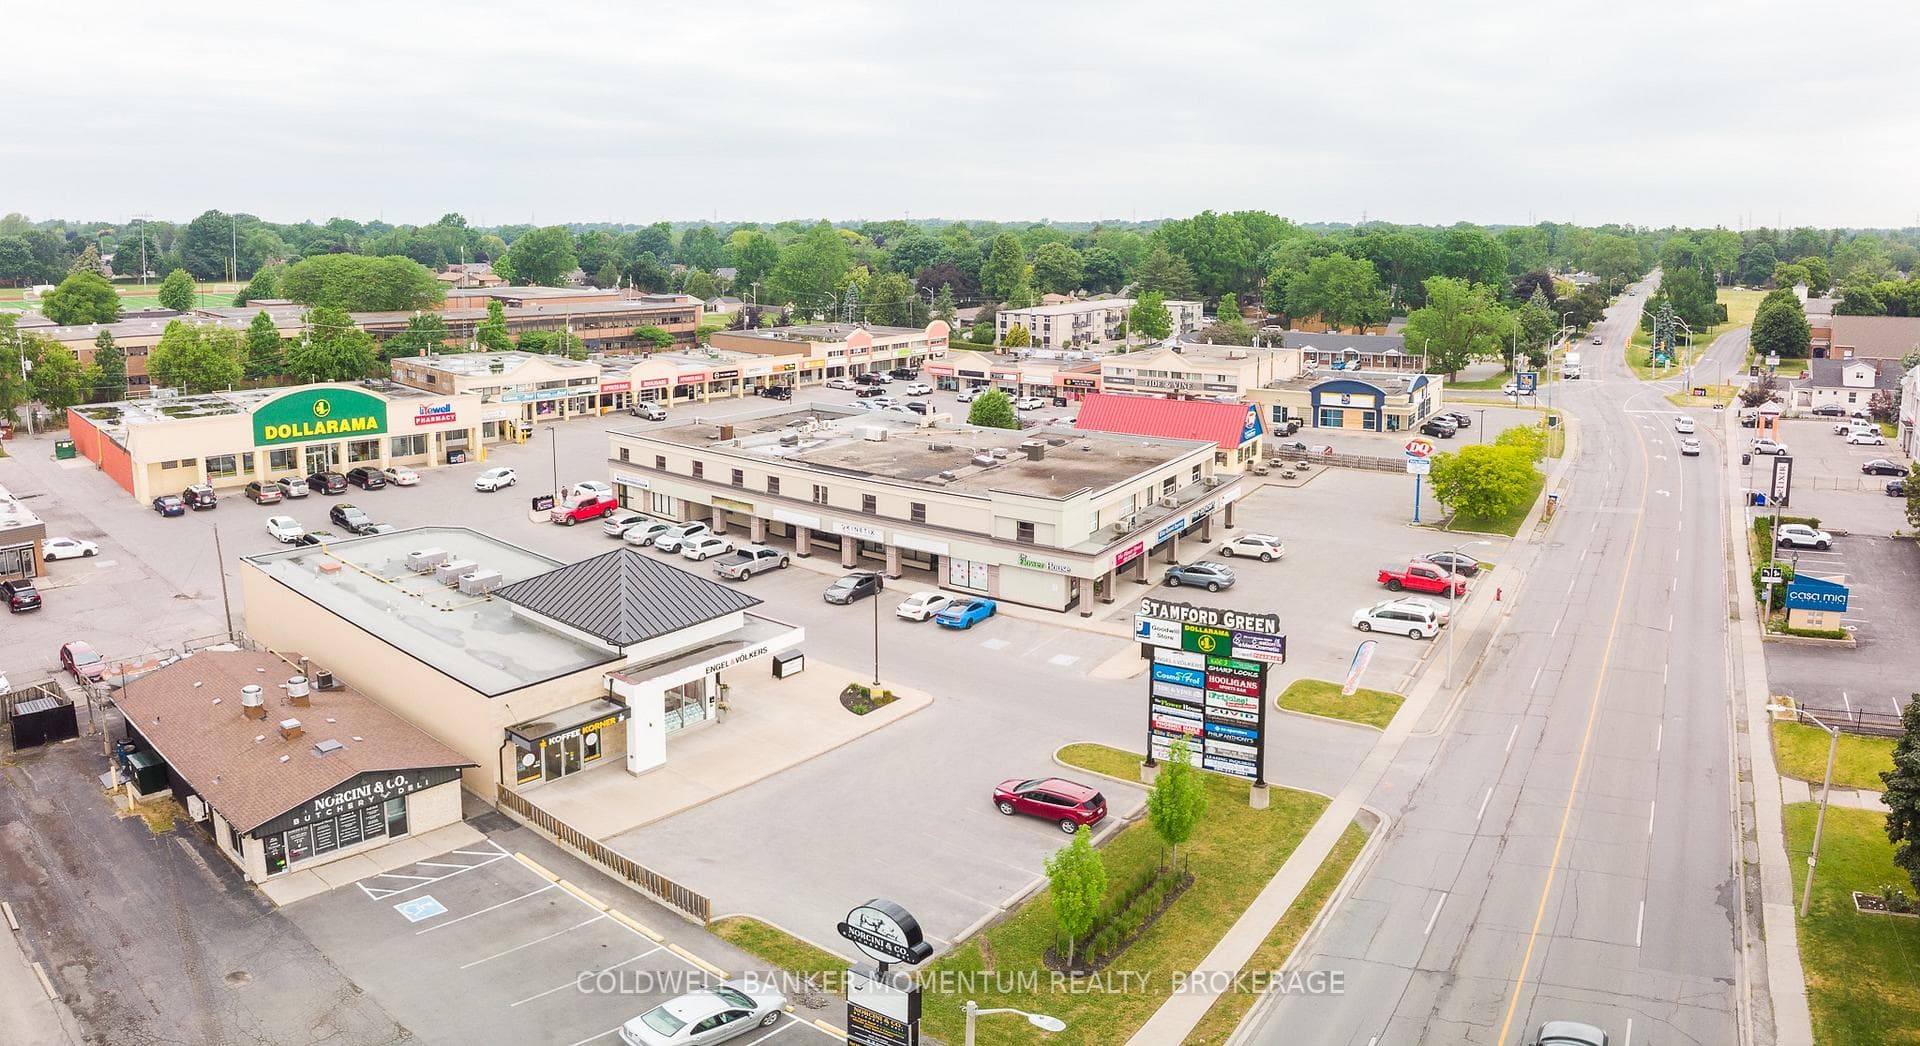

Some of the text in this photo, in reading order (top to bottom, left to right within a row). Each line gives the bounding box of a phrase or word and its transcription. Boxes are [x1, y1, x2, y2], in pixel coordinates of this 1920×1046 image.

[416, 414, 455, 424] PHARMACY
[265, 416, 378, 440] DOLLARAMA
[1410, 442, 1430, 453] DQ
[1019, 558, 1071, 572] Flower House
[1789, 591, 1820, 601] casa
[1822, 593, 1846, 603] mia
[1141, 599, 1276, 634] STAMFORD GREEN
[1184, 625, 1230, 637] DOLLARAMA
[1156, 671, 1201, 685] Cosmo Prof
[1208, 665, 1259, 678] SHARP LOOKS
[1209, 675, 1258, 689] HOOLIGANS
[548, 717, 616, 746] KOFFEE KORNER
[314, 775, 408, 811] NORCINI & CO.
[293, 796, 375, 826] BUTCHERY
[398, 779, 429, 794] DELI
[848, 926, 910, 957] NORCINI & CO.
